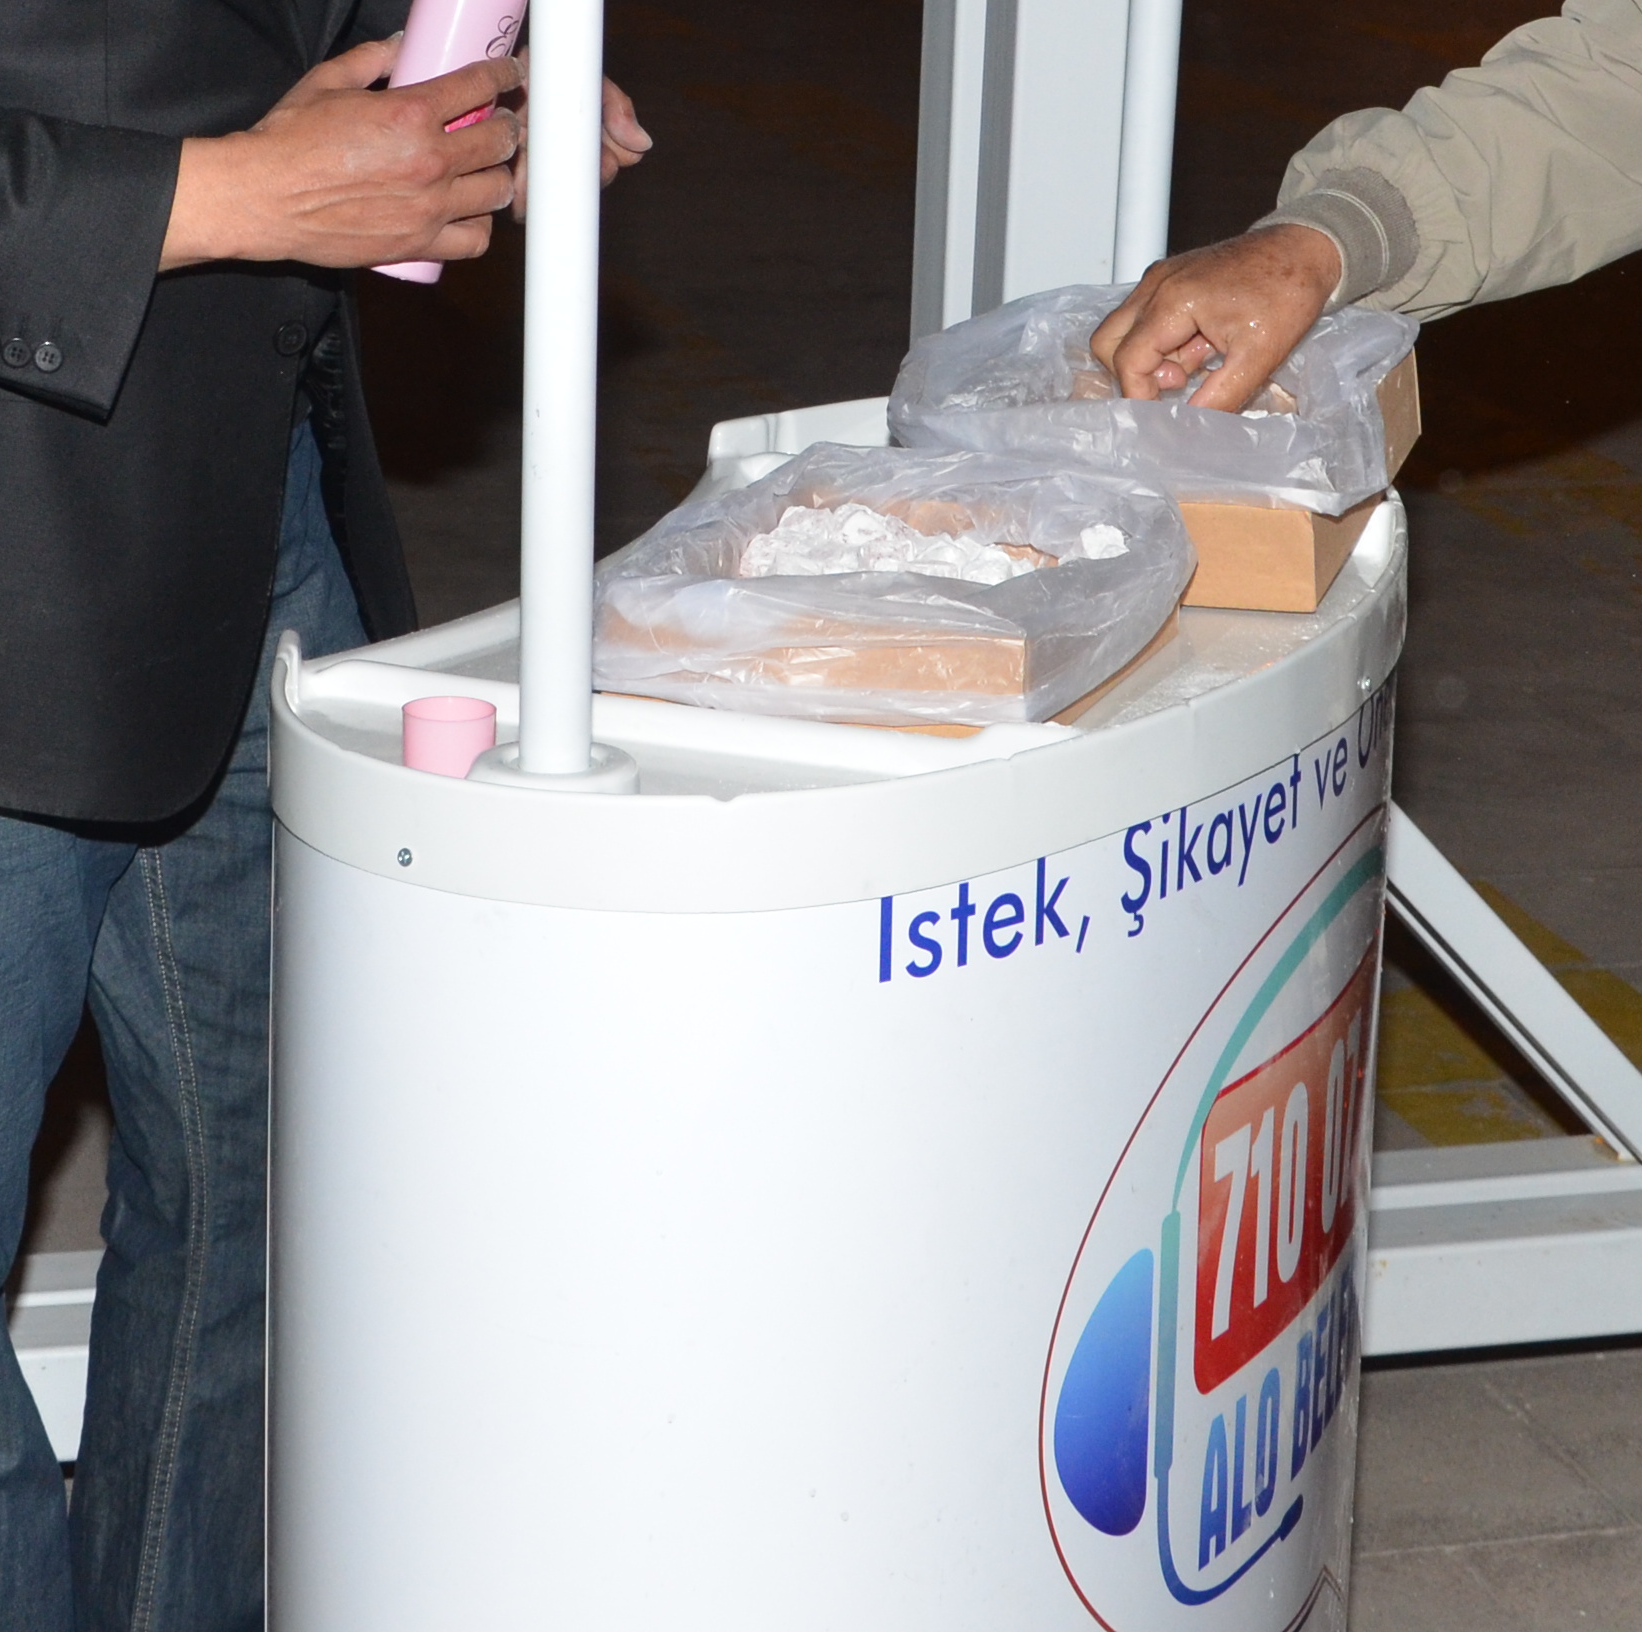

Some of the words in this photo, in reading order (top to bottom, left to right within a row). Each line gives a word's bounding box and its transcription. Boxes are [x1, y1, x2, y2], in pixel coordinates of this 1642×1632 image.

[1121, 754, 1302, 937] Şikayet
[1314, 737, 1348, 810] ve
[1211, 1082, 1309, 1342] 710
[1198, 1367, 1281, 1572] ALO
